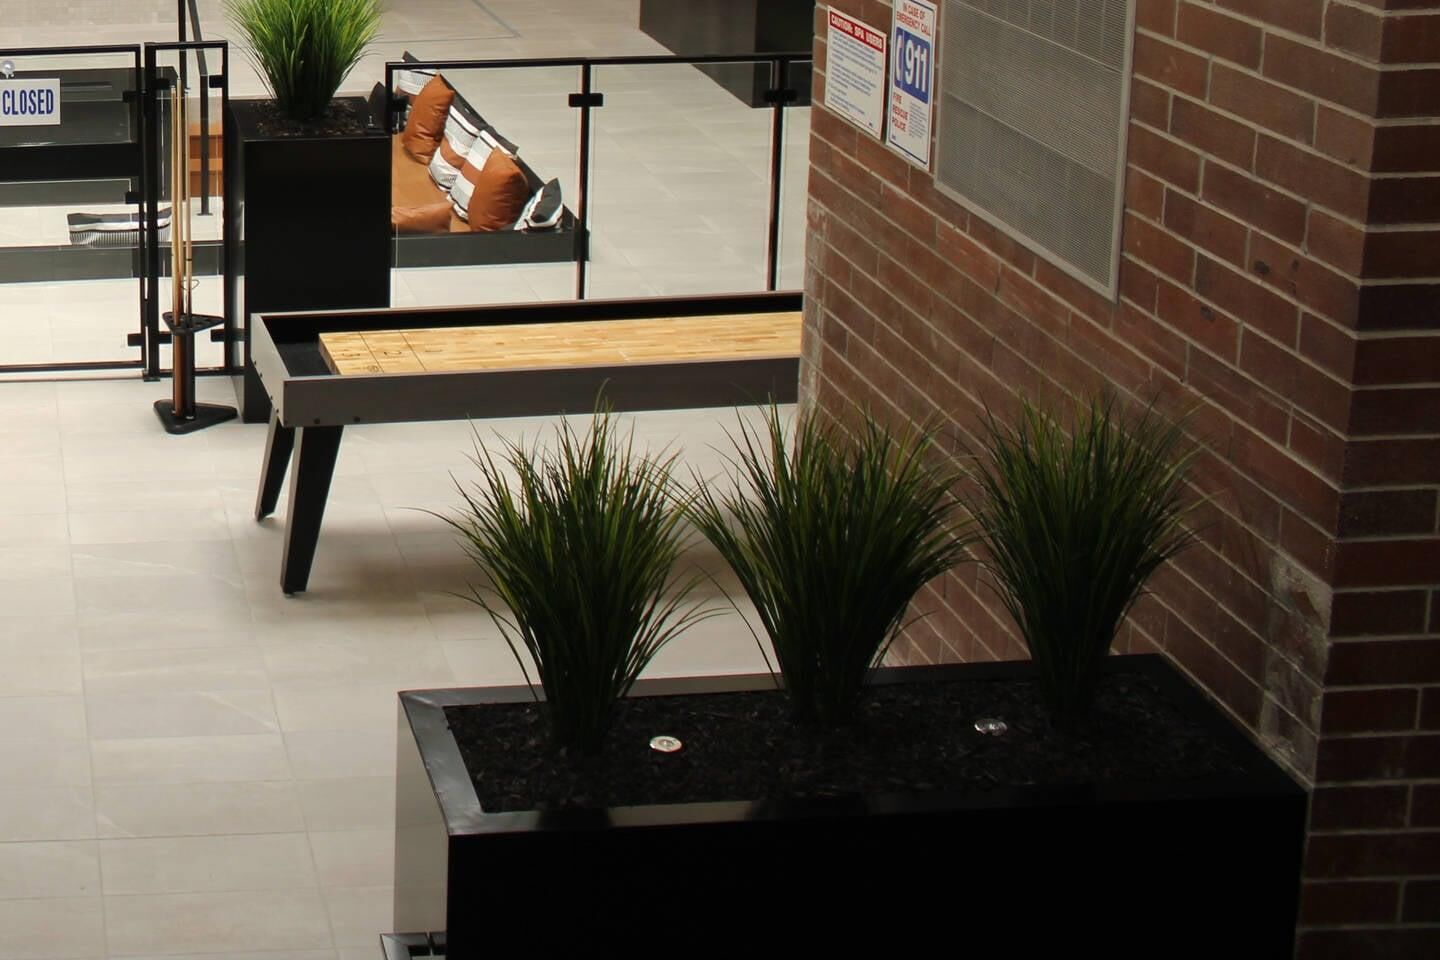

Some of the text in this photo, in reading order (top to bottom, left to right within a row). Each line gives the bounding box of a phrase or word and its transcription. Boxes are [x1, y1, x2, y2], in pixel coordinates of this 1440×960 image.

[908, 4, 919, 19] CASE
[896, 10, 931, 37] EMERGENCY CALL
[853, 25, 865, 41] SPA
[865, 31, 883, 50] USERS
[905, 39, 928, 92] 911
[2, 88, 54, 116] CLOSED
[892, 91, 903, 105] FIRE
[892, 103, 909, 121] RESCUE
[891, 116, 907, 133] POLICE
